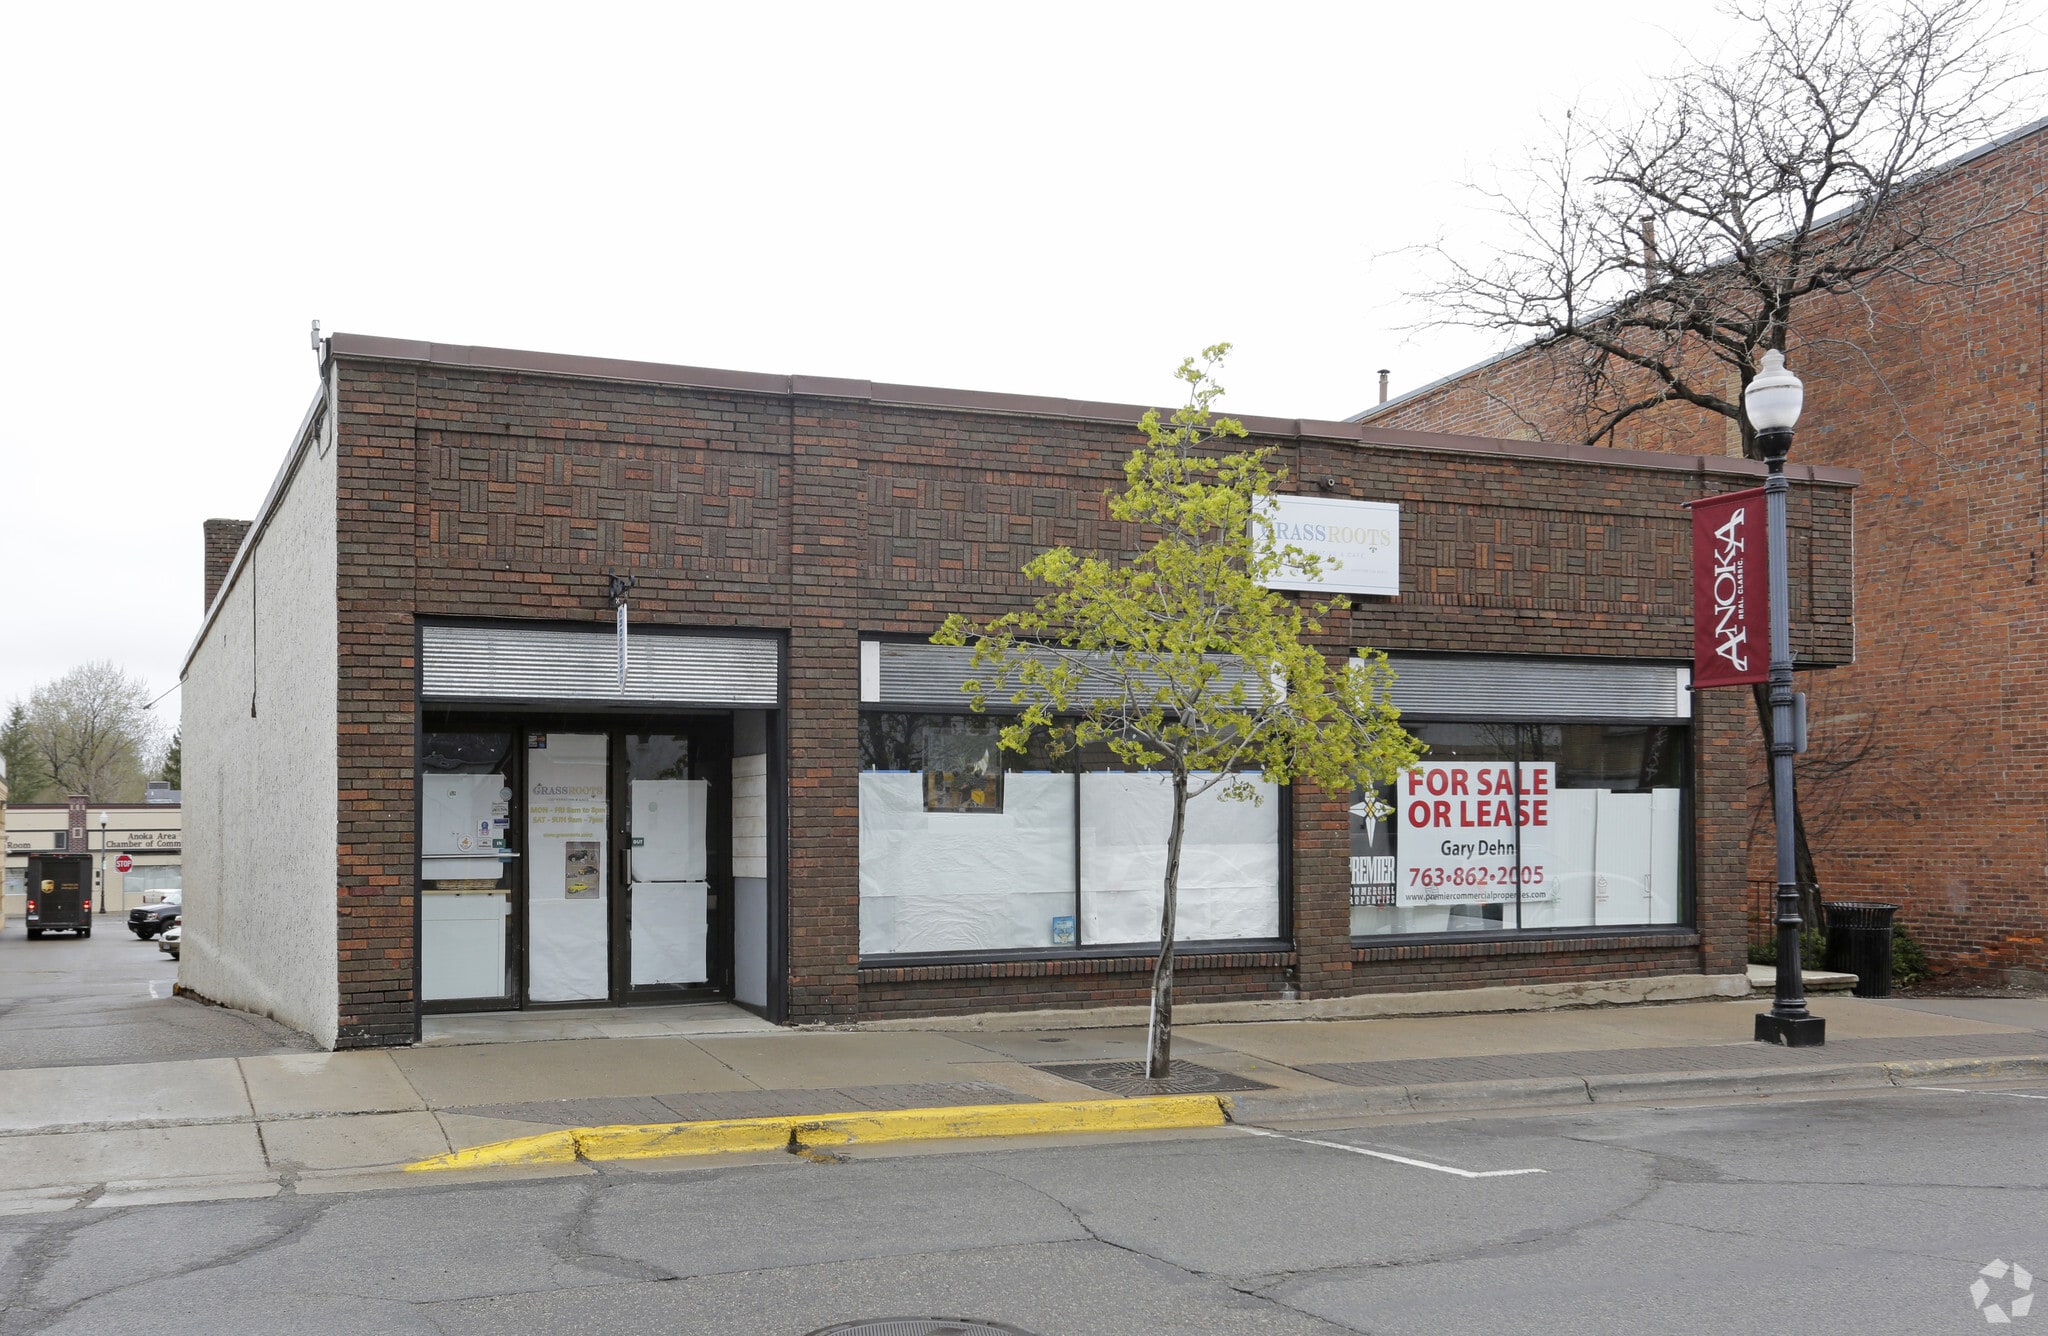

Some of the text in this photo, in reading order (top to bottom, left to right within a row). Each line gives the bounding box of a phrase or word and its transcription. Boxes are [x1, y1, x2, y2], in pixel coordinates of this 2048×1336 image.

[1714, 507, 1748, 672] ANOKA
[1408, 768, 1549, 796] FOR SALE
[532, 785, 603, 796] GRASSROOTS
[1408, 799, 1549, 828] OR LEASE
[7, 841, 31, 849] Room
[106, 840, 181, 848] Chamber of Comm
[1441, 839, 1514, 860] Gary Dehn
[116, 860, 132, 868] STOP
[1349, 856, 1396, 885] REMIER
[1350, 886, 1396, 896] MMERCIAL
[1405, 891, 1547, 902] www.premiercommercialproperes.com
